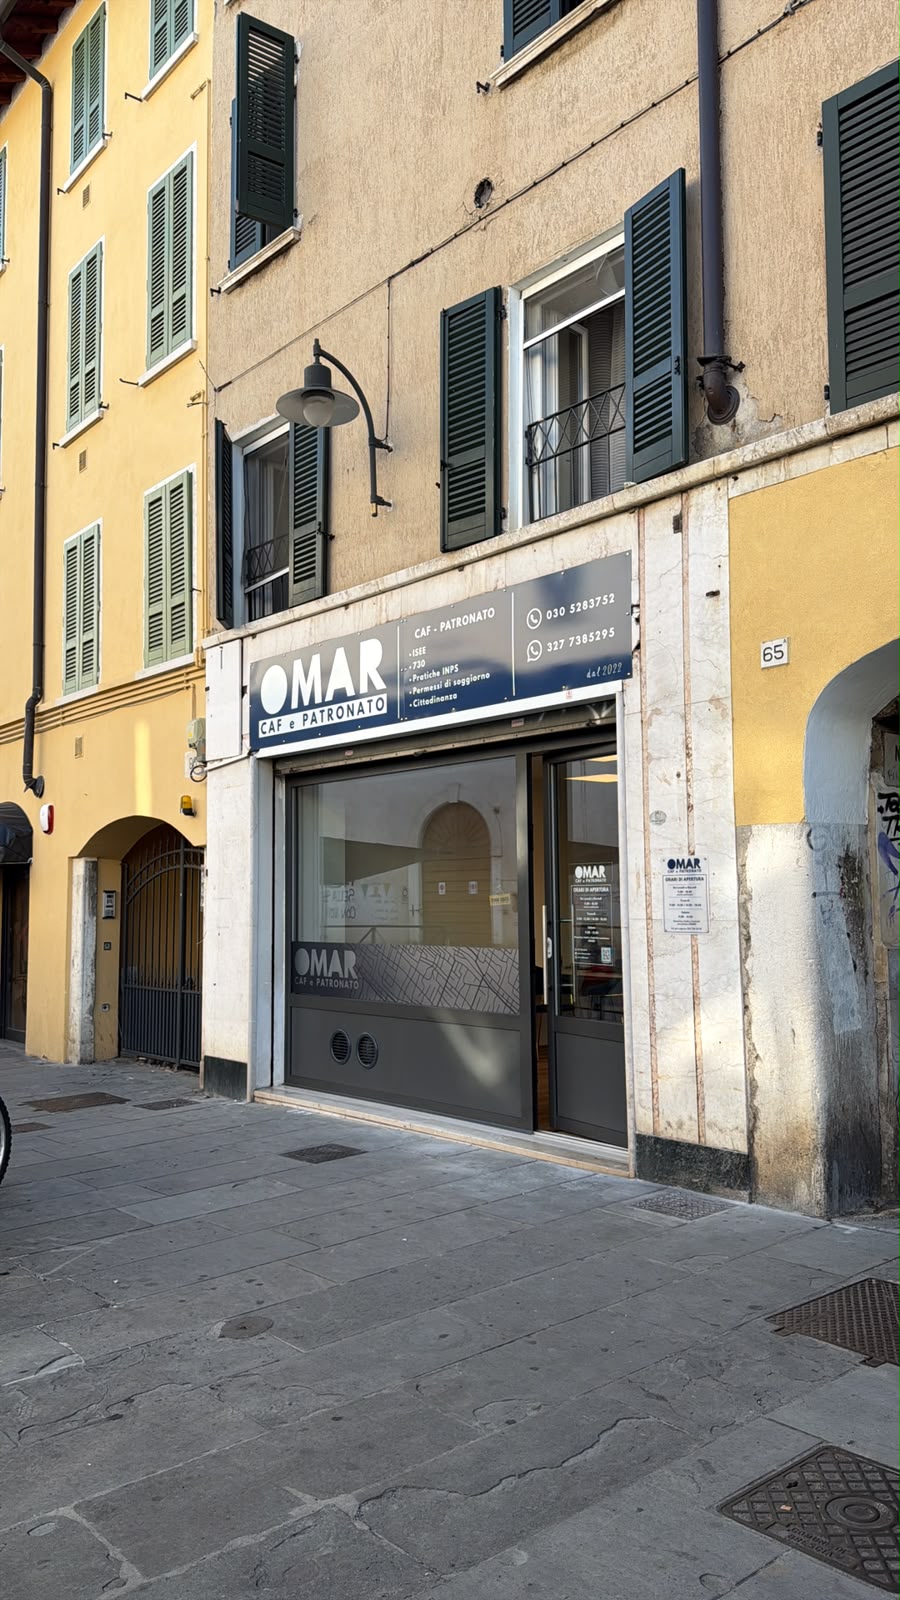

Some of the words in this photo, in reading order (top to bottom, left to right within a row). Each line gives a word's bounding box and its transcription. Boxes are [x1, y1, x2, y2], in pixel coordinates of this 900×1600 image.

[546, 606, 565, 620] 030
[570, 593, 615, 614] 5283752
[414, 625, 431, 638] CAF
[440, 608, 495, 632] PATRONATO
[547, 639, 565, 652] 327
[569, 627, 615, 647] 7385295
[412, 646, 426, 657] ISEE
[763, 644, 784, 662] 65
[412, 659, 426, 670] 730
[412, 670, 440, 682] Pratiche
[442, 664, 459, 675] INPS
[586, 666, 600, 678] dal
[602, 662, 622, 676] 2022
[261, 638, 387, 715] OMAR
[412, 681, 442, 695] Permessi
[444, 679, 451, 688] di
[453, 672, 490, 686] soggiorno
[412, 693, 458, 707] Cittadinanza
[260, 719, 282, 734] CAF
[290, 720, 295, 729] e
[303, 697, 385, 726] PATRONATO
[575, 865, 606, 878] OMAR
[667, 858, 701, 869] OMAR
[295, 948, 358, 980] OMAR
[295, 977, 306, 985] CAF
[316, 978, 359, 989] PATRONATO
